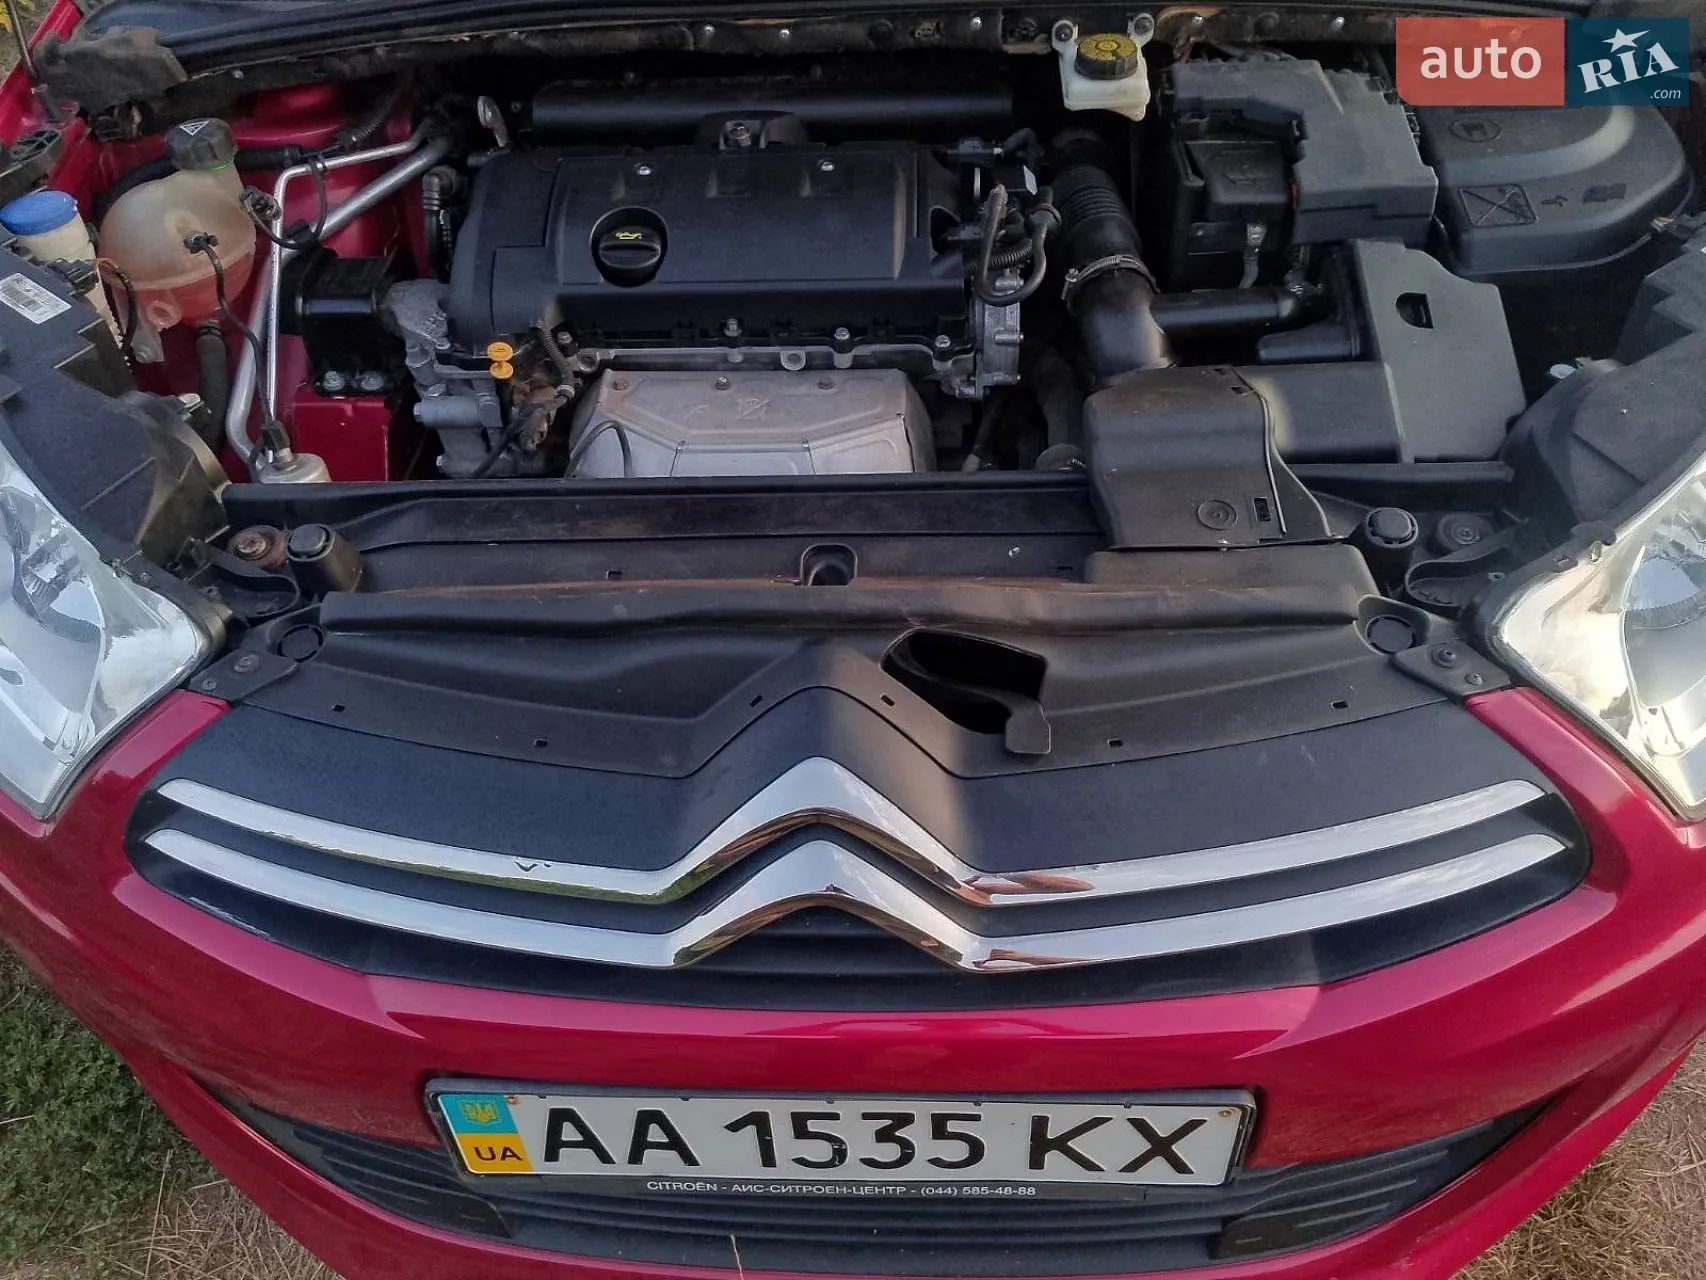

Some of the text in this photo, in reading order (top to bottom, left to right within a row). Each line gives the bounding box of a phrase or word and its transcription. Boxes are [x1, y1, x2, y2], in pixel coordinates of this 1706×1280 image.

[543, 1107, 1208, 1175] AA 1535 KX
[474, 1146, 524, 1163] UA
[731, 1183, 907, 1196] АИС-СИТРОЕН-ЦЕНТР
[920, 1186, 958, 1196] (044)
[962, 1186, 1037, 1196] 585-48-88
